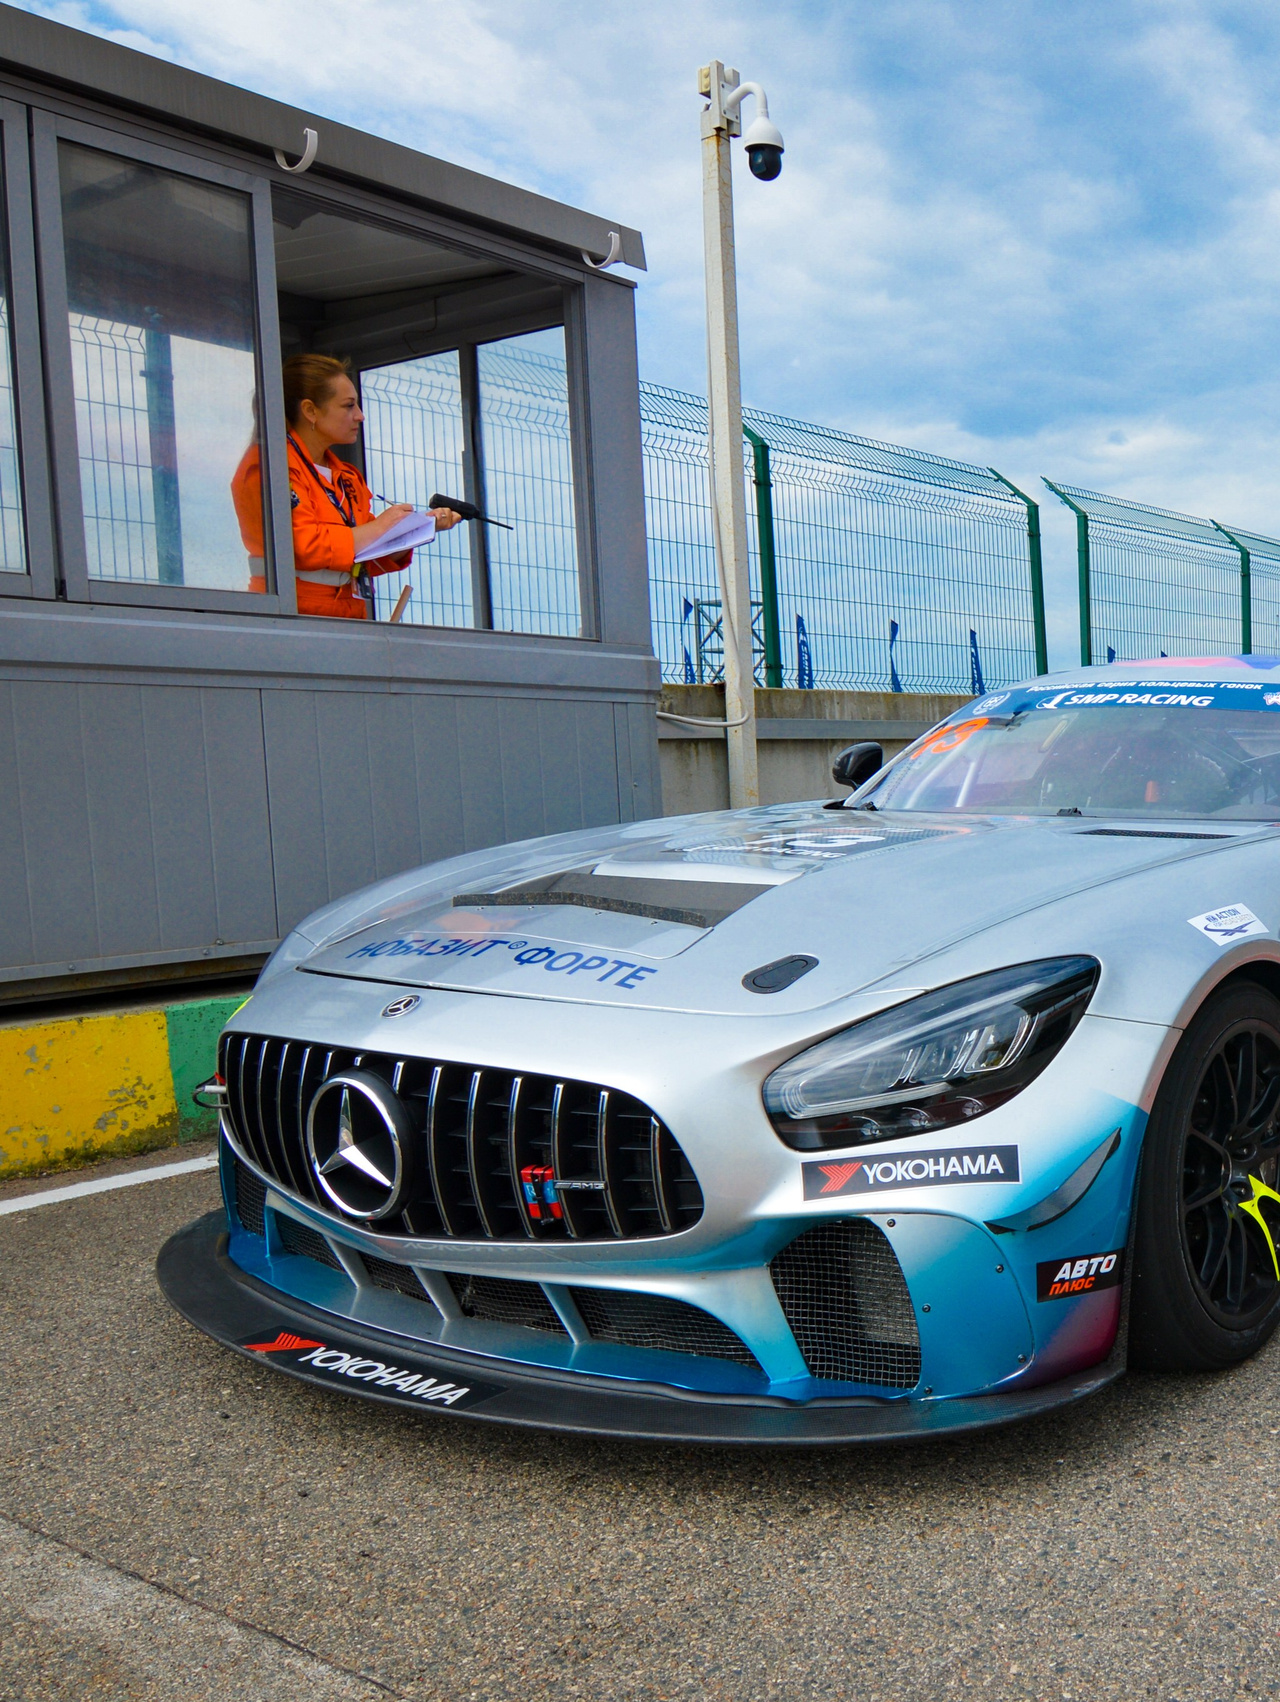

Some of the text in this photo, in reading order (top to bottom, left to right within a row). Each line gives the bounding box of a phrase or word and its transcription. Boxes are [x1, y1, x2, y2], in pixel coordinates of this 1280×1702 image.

[1138, 681, 1217, 689] кольцевых
[1064, 693, 1215, 707] SMP RACING
[513, 945, 658, 990] ФОРТЕ
[861, 1154, 1004, 1184] YOKOHAMA
[569, 1182, 605, 1190] AMG
[1053, 1253, 1117, 1283] АВТО
[1048, 1276, 1096, 1297] ПЛЮС
[297, 1346, 471, 1405] YOKOHAMA
